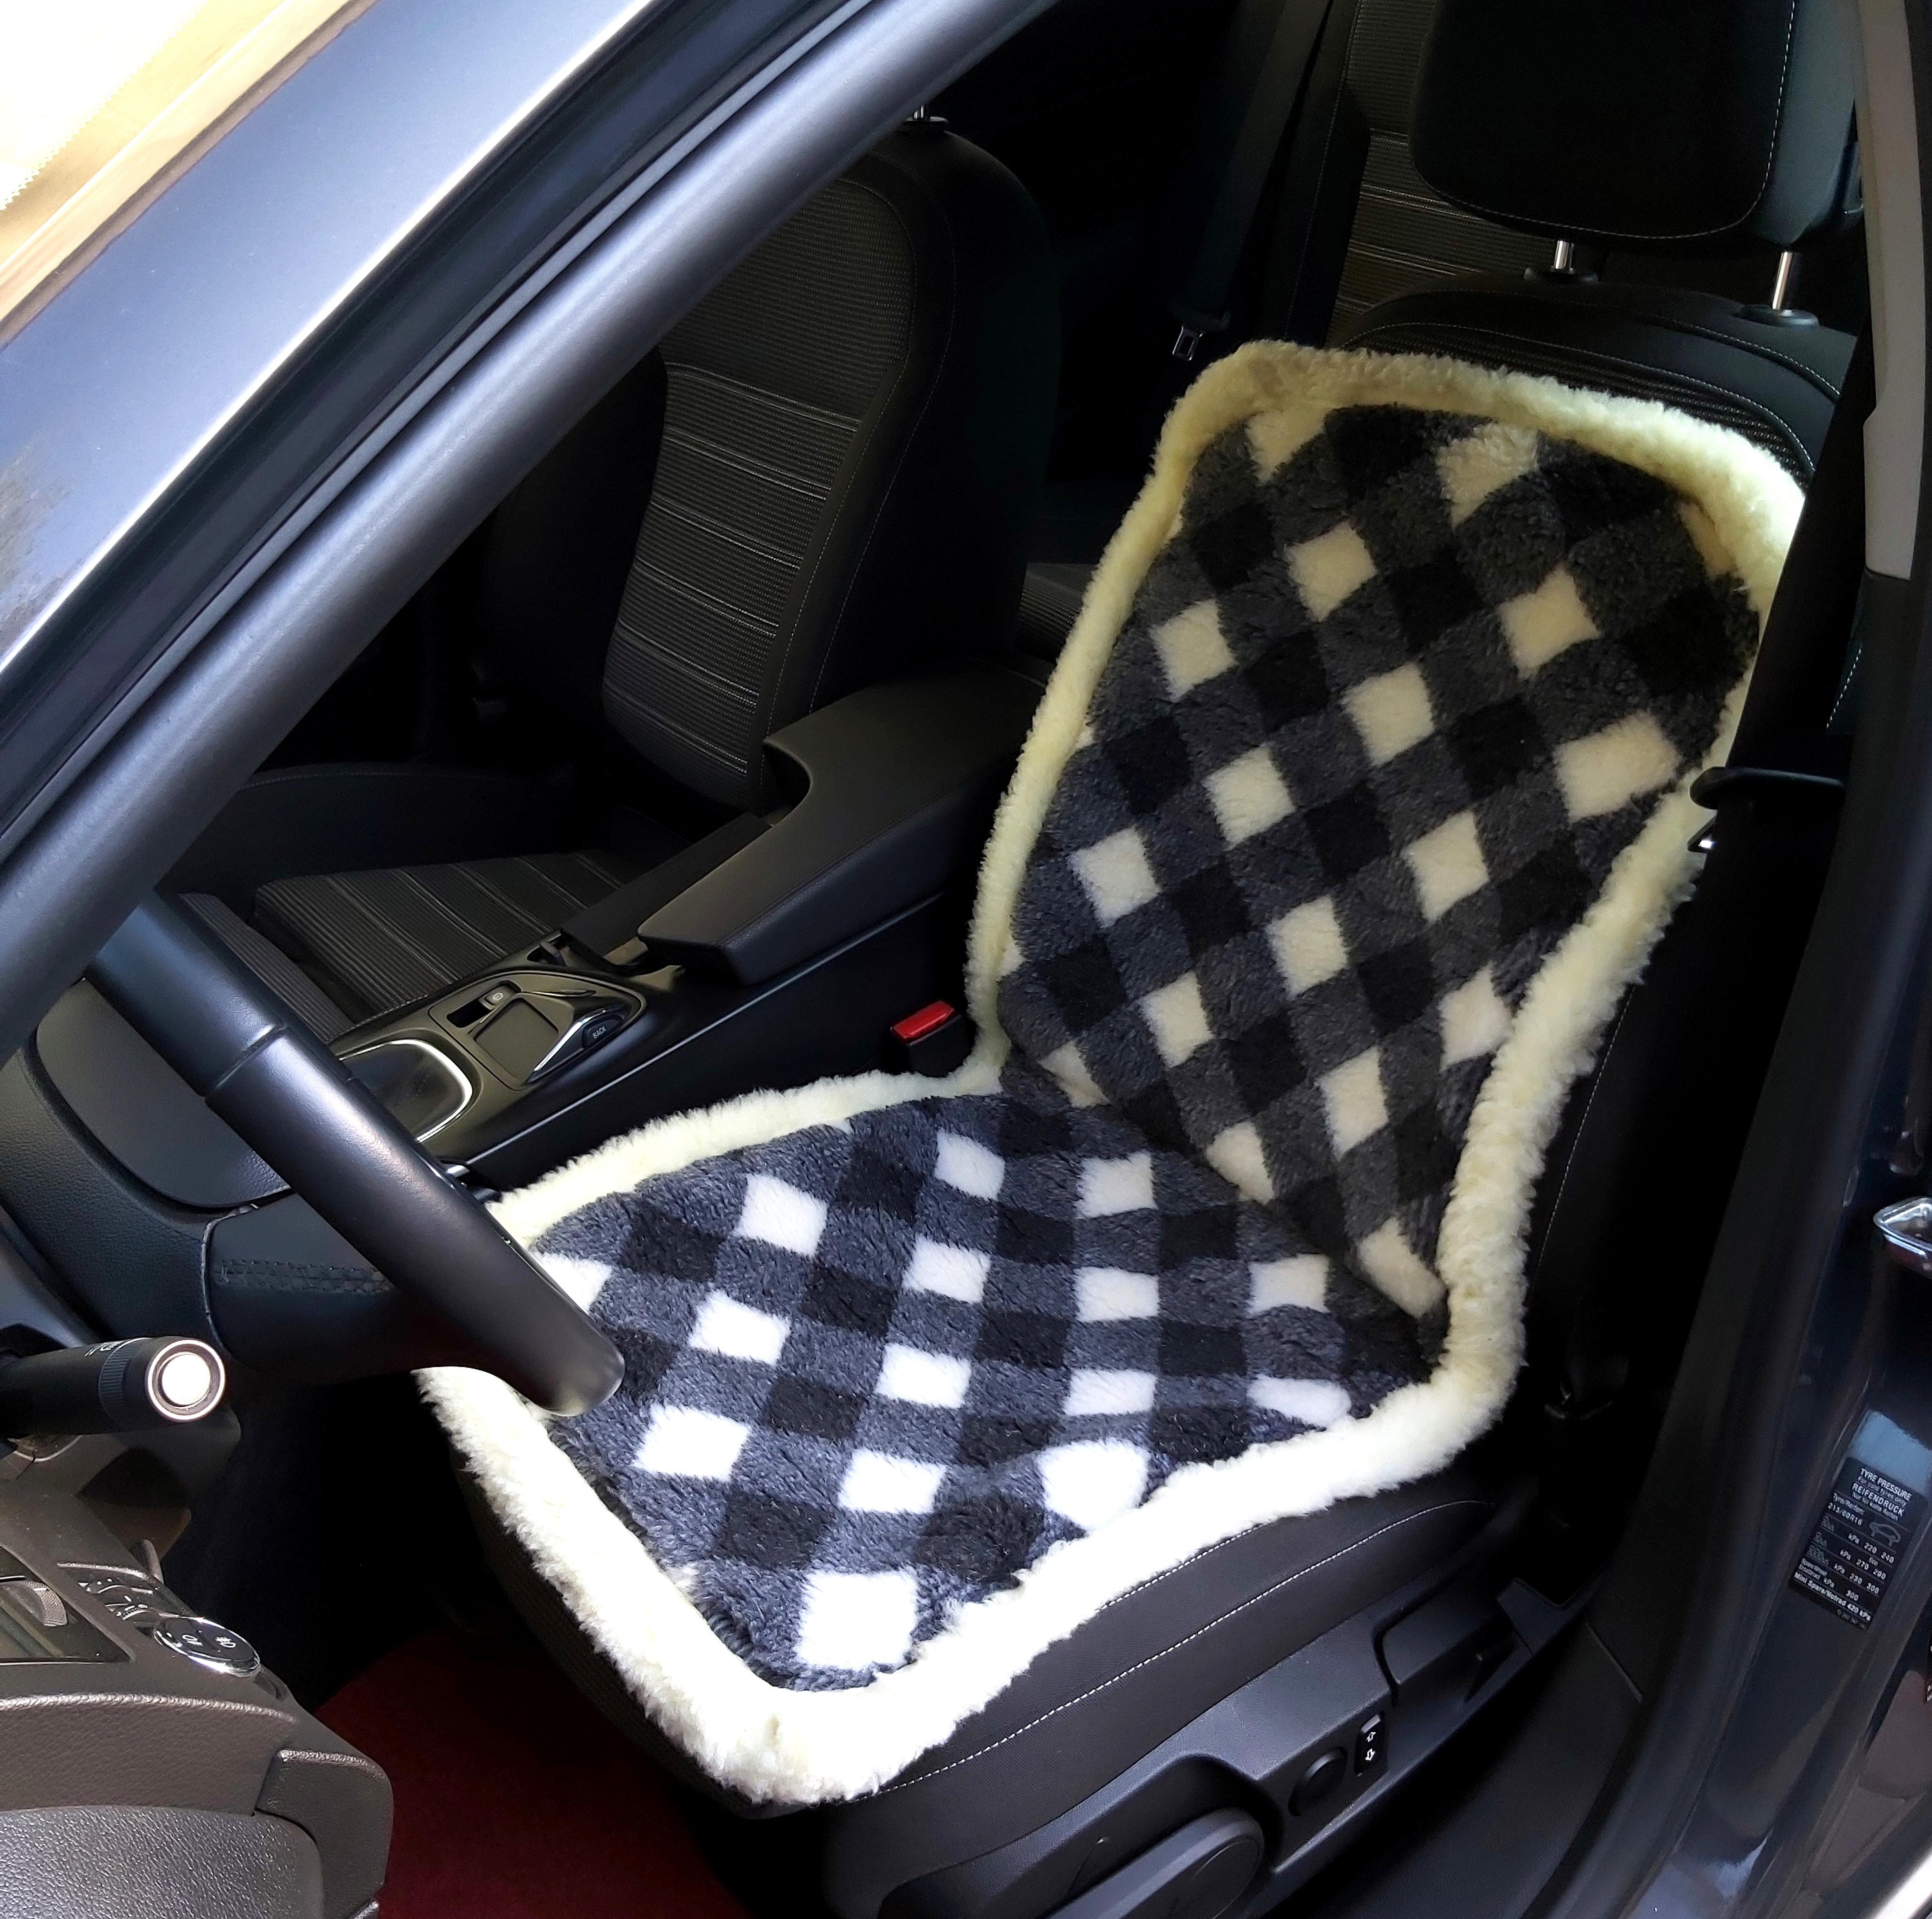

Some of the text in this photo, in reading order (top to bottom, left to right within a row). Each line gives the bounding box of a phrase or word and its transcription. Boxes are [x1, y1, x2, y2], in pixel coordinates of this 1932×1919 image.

[1860, 1467, 1912, 1501] TYRE PRESSURE
[1852, 1483, 1905, 1517] REIFENDRUCK
[1848, 1533, 1859, 1544] kPa
[1839, 1549, 1851, 1560] kPa
[1793, 1571, 1808, 1584] Mini
[1846, 1603, 1859, 1613] 420
[1866, 1582, 1879, 1594] 300
[1845, 1589, 1859, 1601] 300
